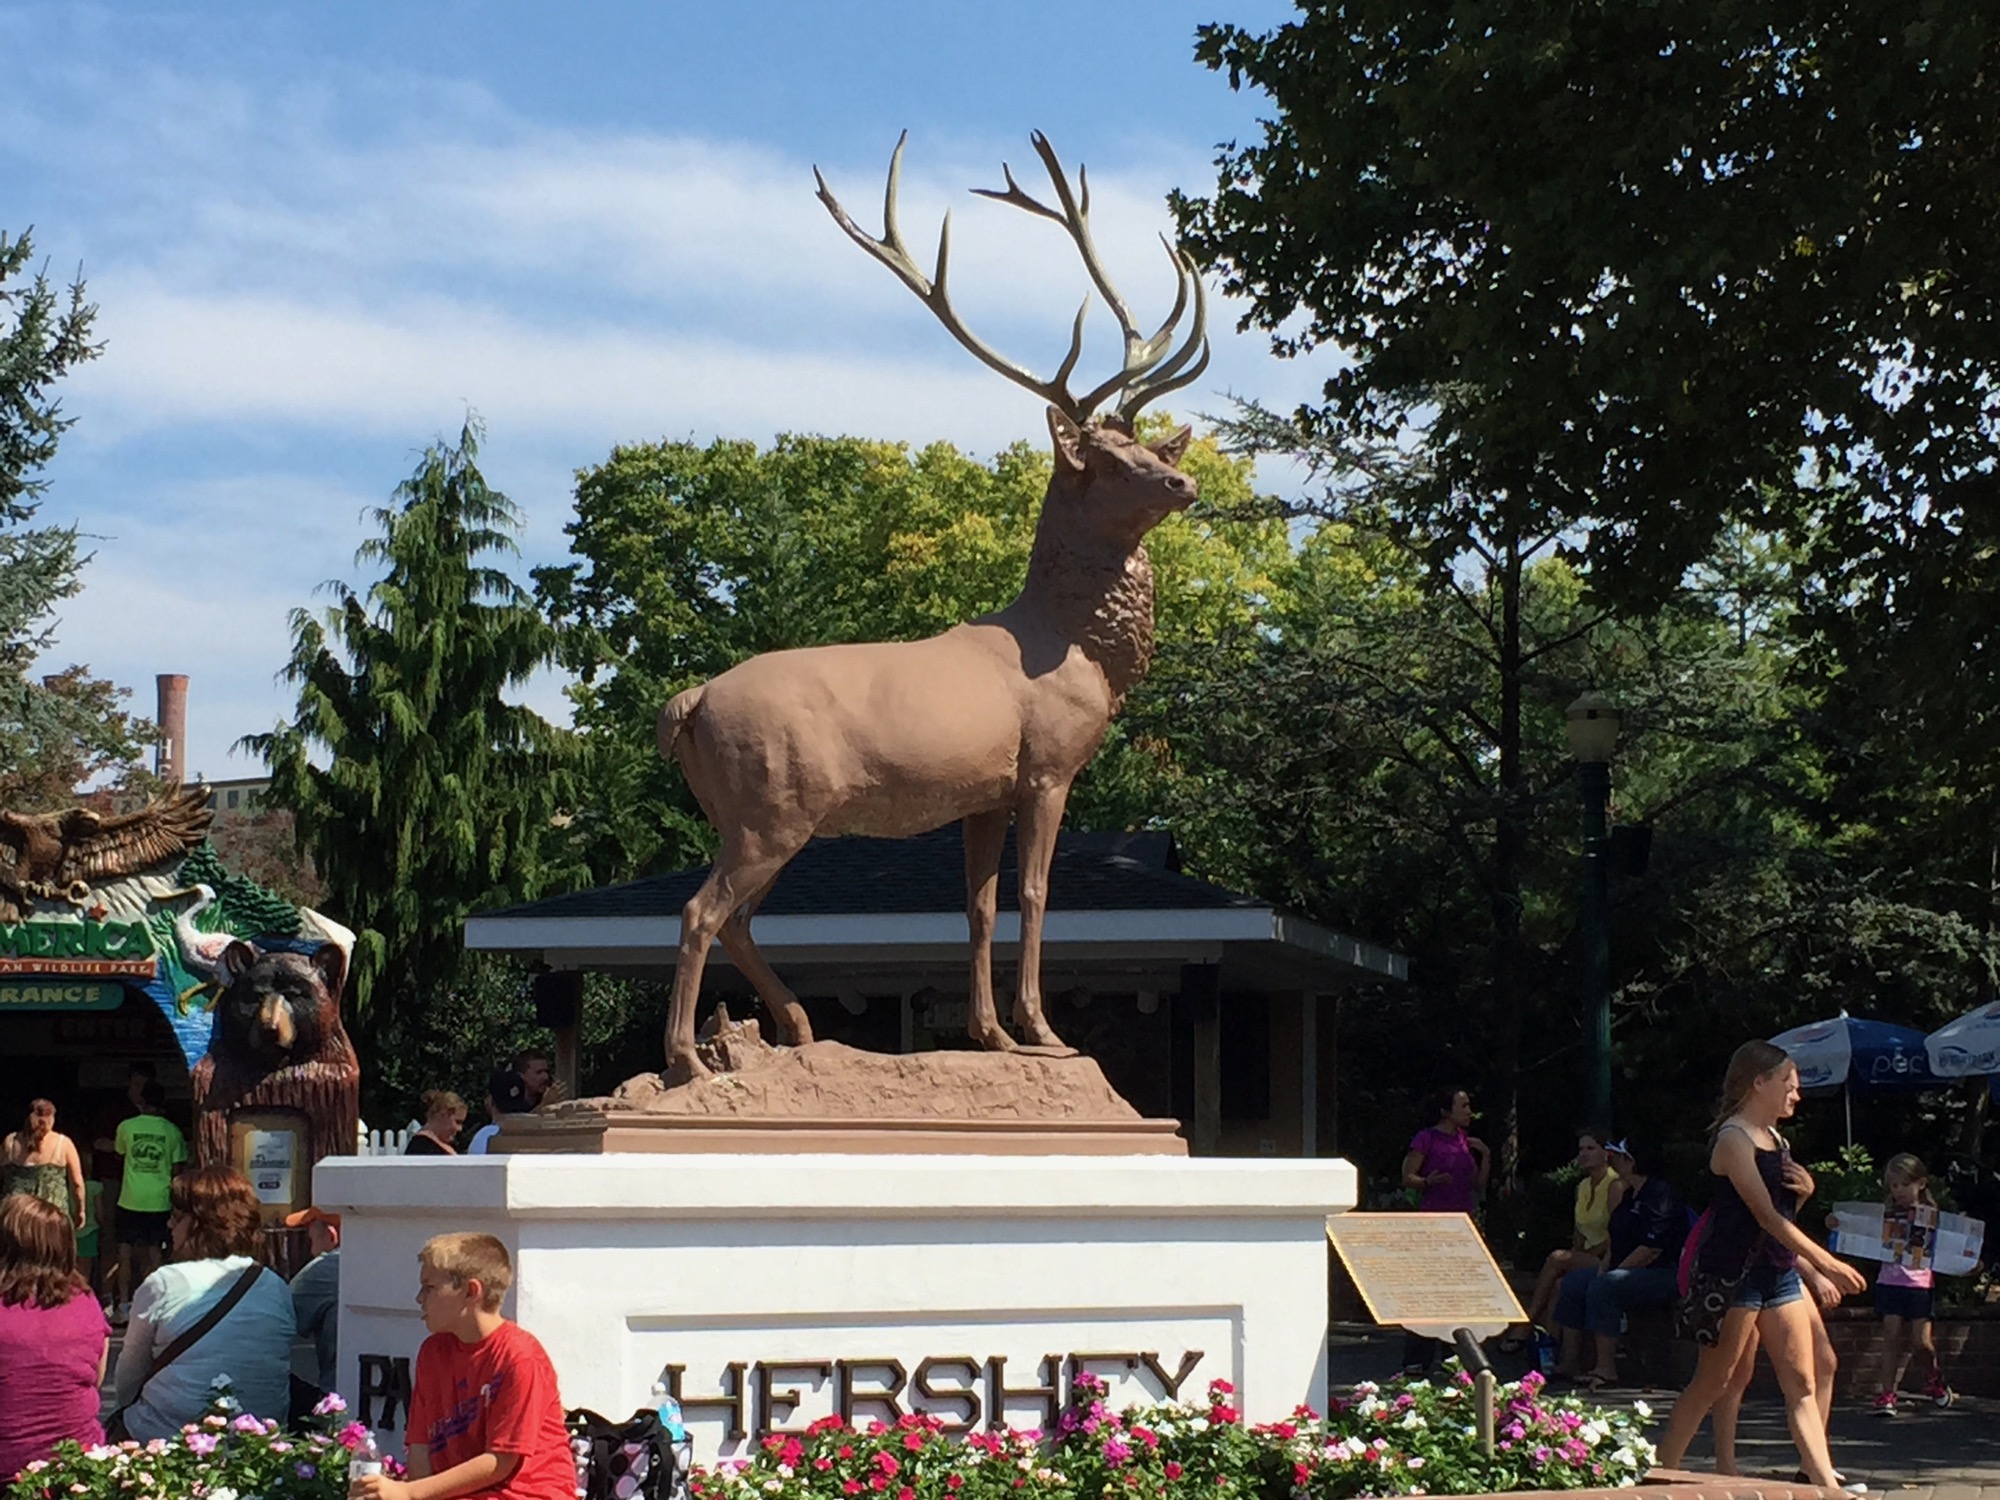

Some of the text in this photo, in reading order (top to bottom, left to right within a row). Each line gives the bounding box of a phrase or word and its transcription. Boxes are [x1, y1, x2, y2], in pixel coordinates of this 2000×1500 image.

[32, 963, 100, 974] WILDLIFE
[1, 987, 101, 1004] RANCE
[666, 1351, 1204, 1440] HERSHEY
